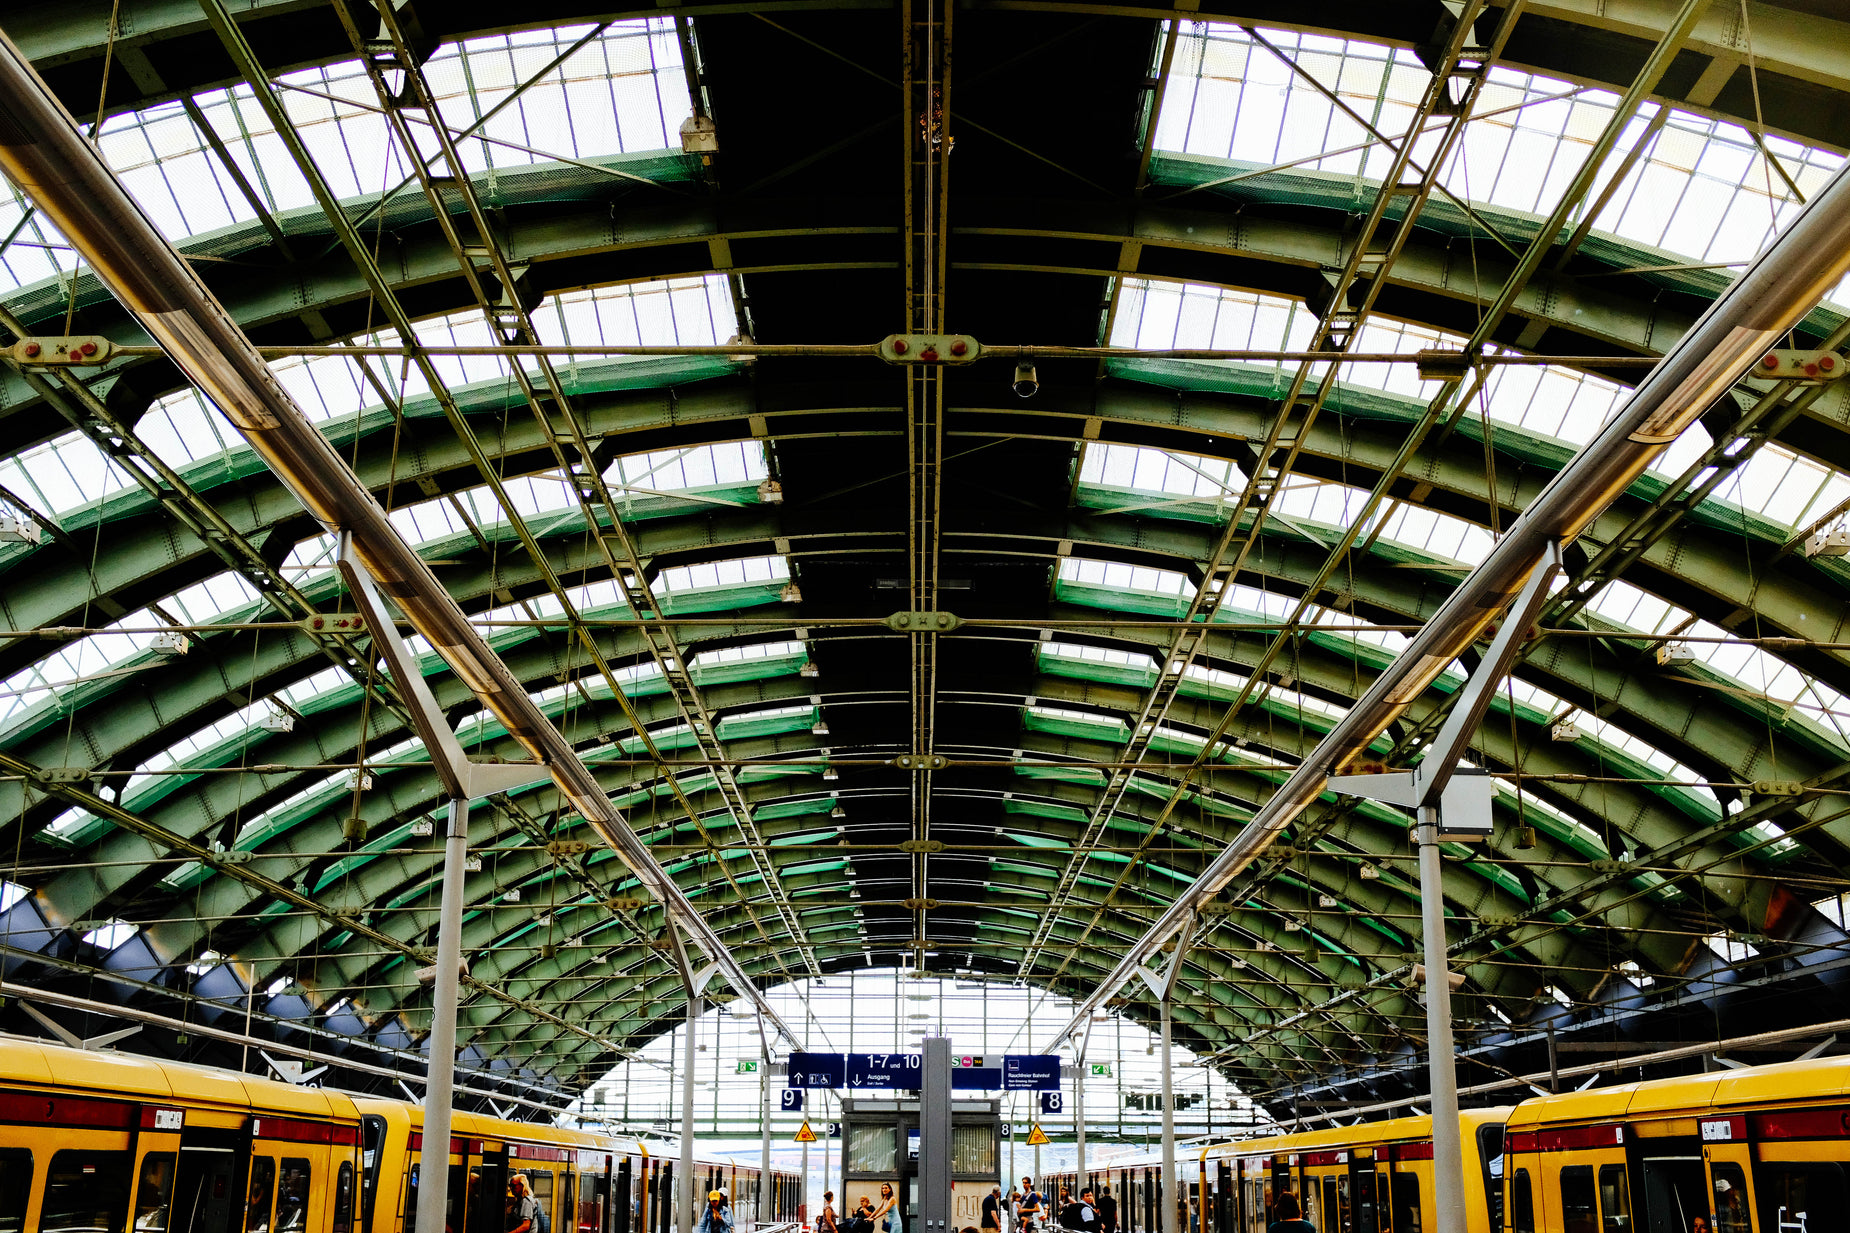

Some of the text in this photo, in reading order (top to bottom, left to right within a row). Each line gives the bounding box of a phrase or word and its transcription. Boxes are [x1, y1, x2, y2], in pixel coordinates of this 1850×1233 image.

[867, 1054, 889, 1068] 1-7
[903, 1054, 920, 1068] 10
[951, 1056, 960, 1066] S
[783, 1090, 795, 1106] 9
[1049, 1093, 1060, 1109] 8
[829, 1123, 836, 1135] 9
[1001, 1123, 1009, 1135] 8
